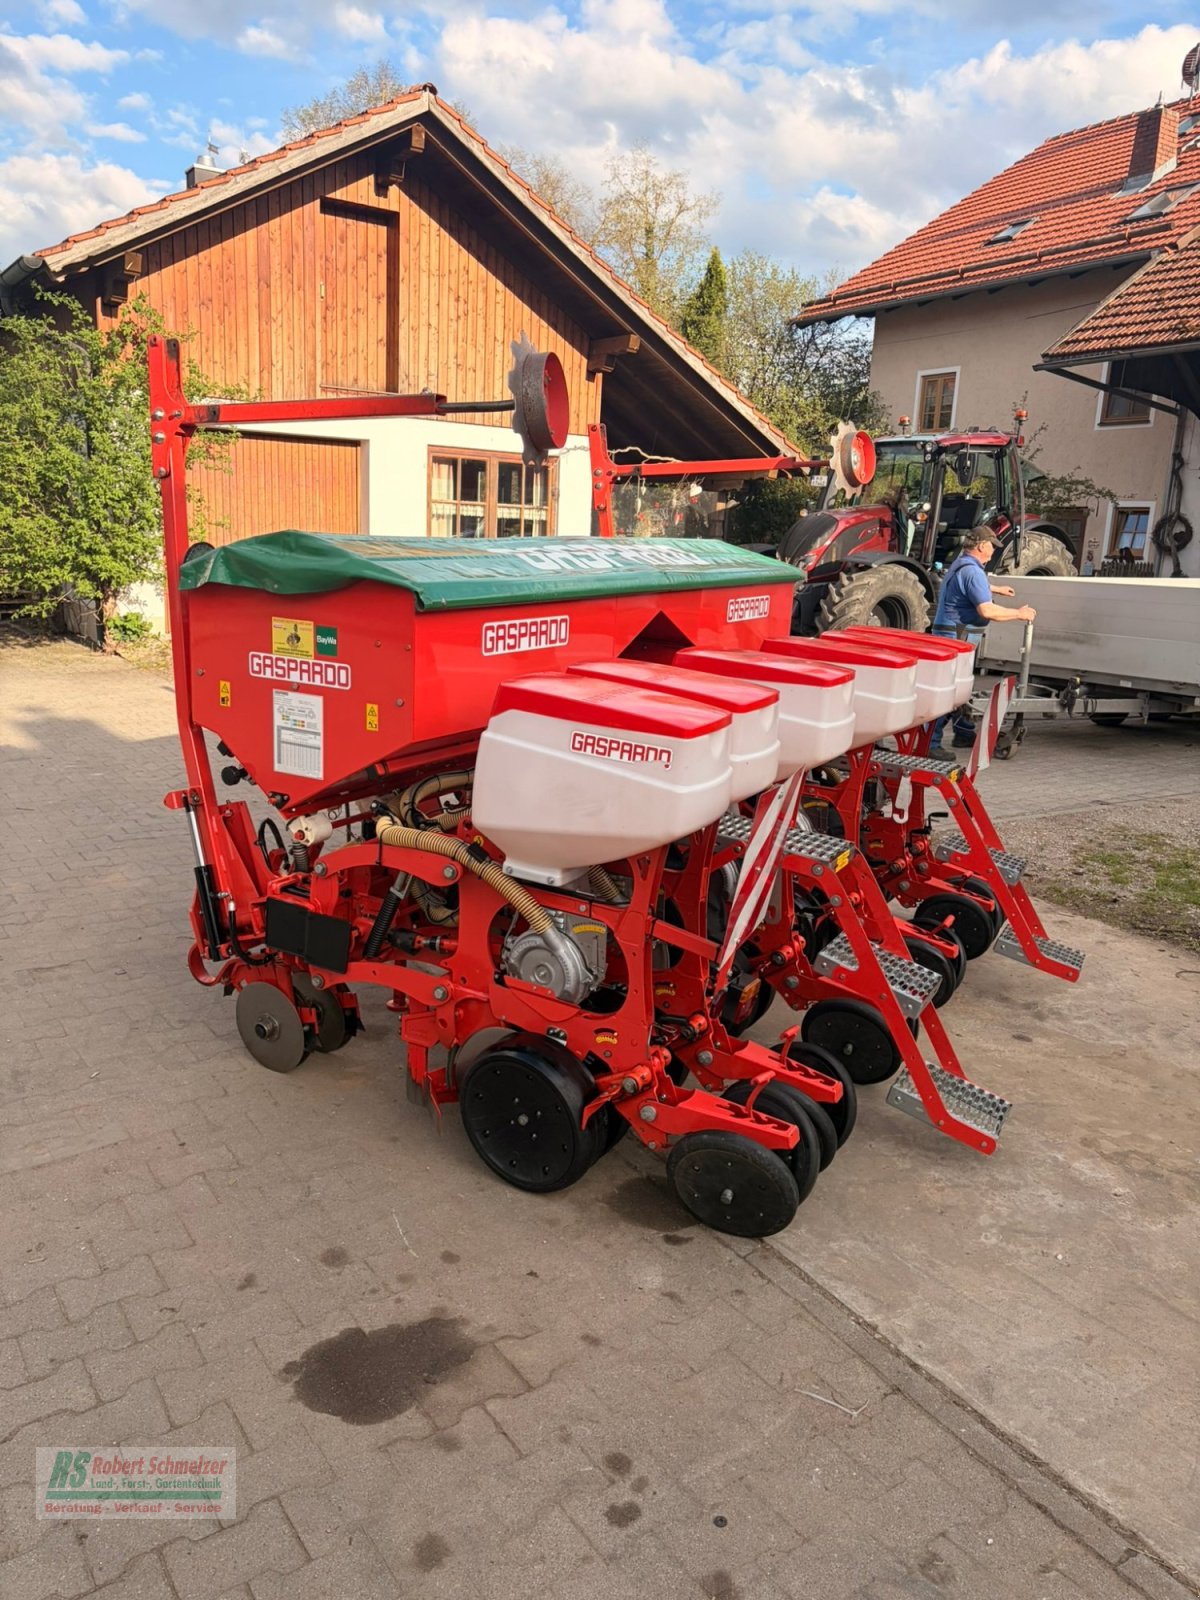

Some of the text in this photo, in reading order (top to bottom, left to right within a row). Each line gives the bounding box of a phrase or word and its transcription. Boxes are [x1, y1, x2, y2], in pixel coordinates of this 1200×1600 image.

[728, 597, 770, 621] GASPARDO
[316, 634, 337, 646] BayWa
[483, 617, 568, 653] GASPARDO
[250, 653, 349, 688] GASPARDO
